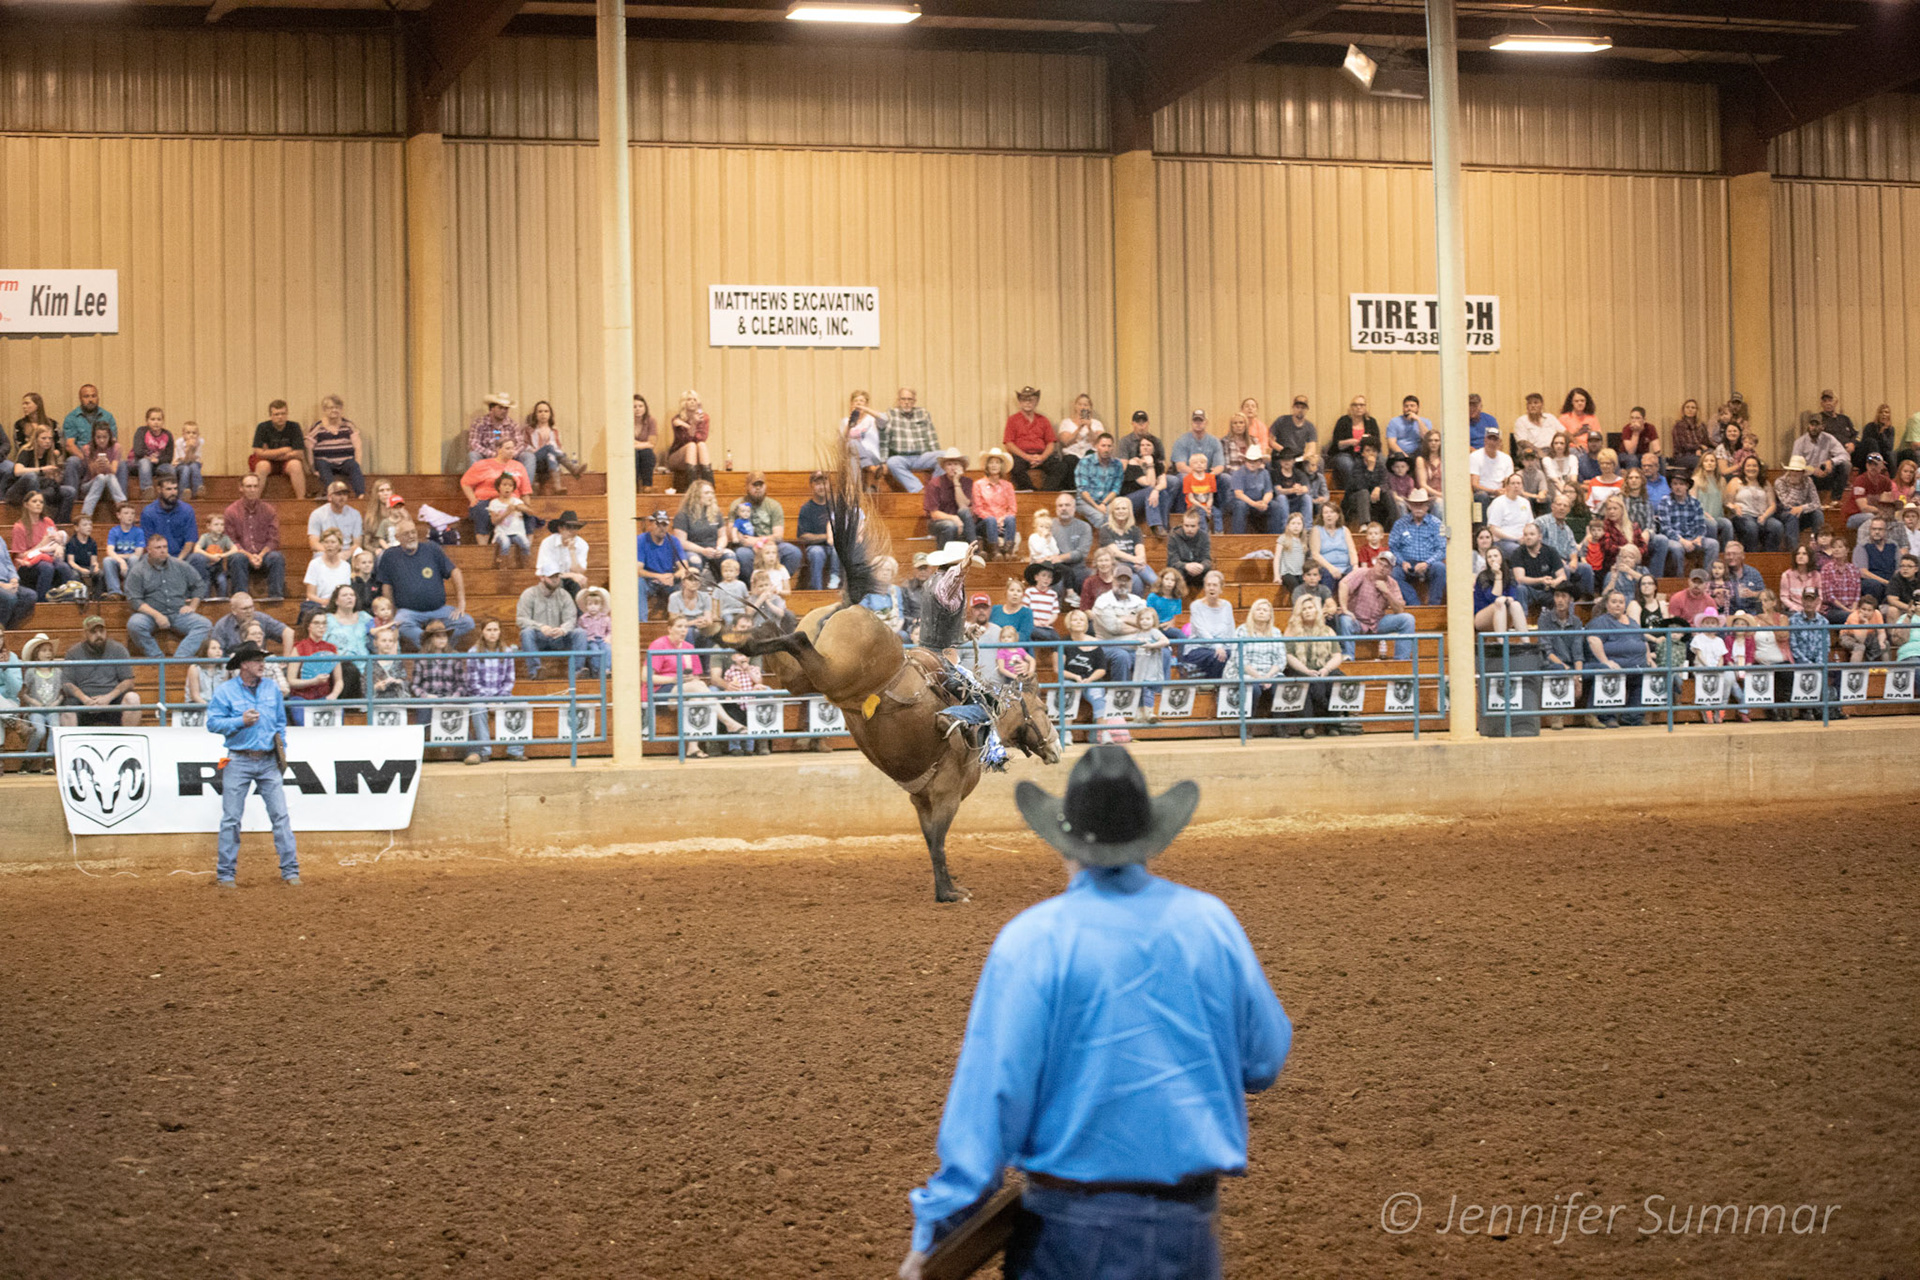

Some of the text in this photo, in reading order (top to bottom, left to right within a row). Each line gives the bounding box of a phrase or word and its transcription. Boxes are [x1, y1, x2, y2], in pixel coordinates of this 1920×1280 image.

[30, 285, 107, 316] Kim Lee
[714, 292, 874, 311] MATTHEWS EXCAVATING
[1357, 300, 1494, 330] TIRE TH
[738, 316, 853, 339] & CLEARING, INC.
[178, 760, 417, 796] RAM
